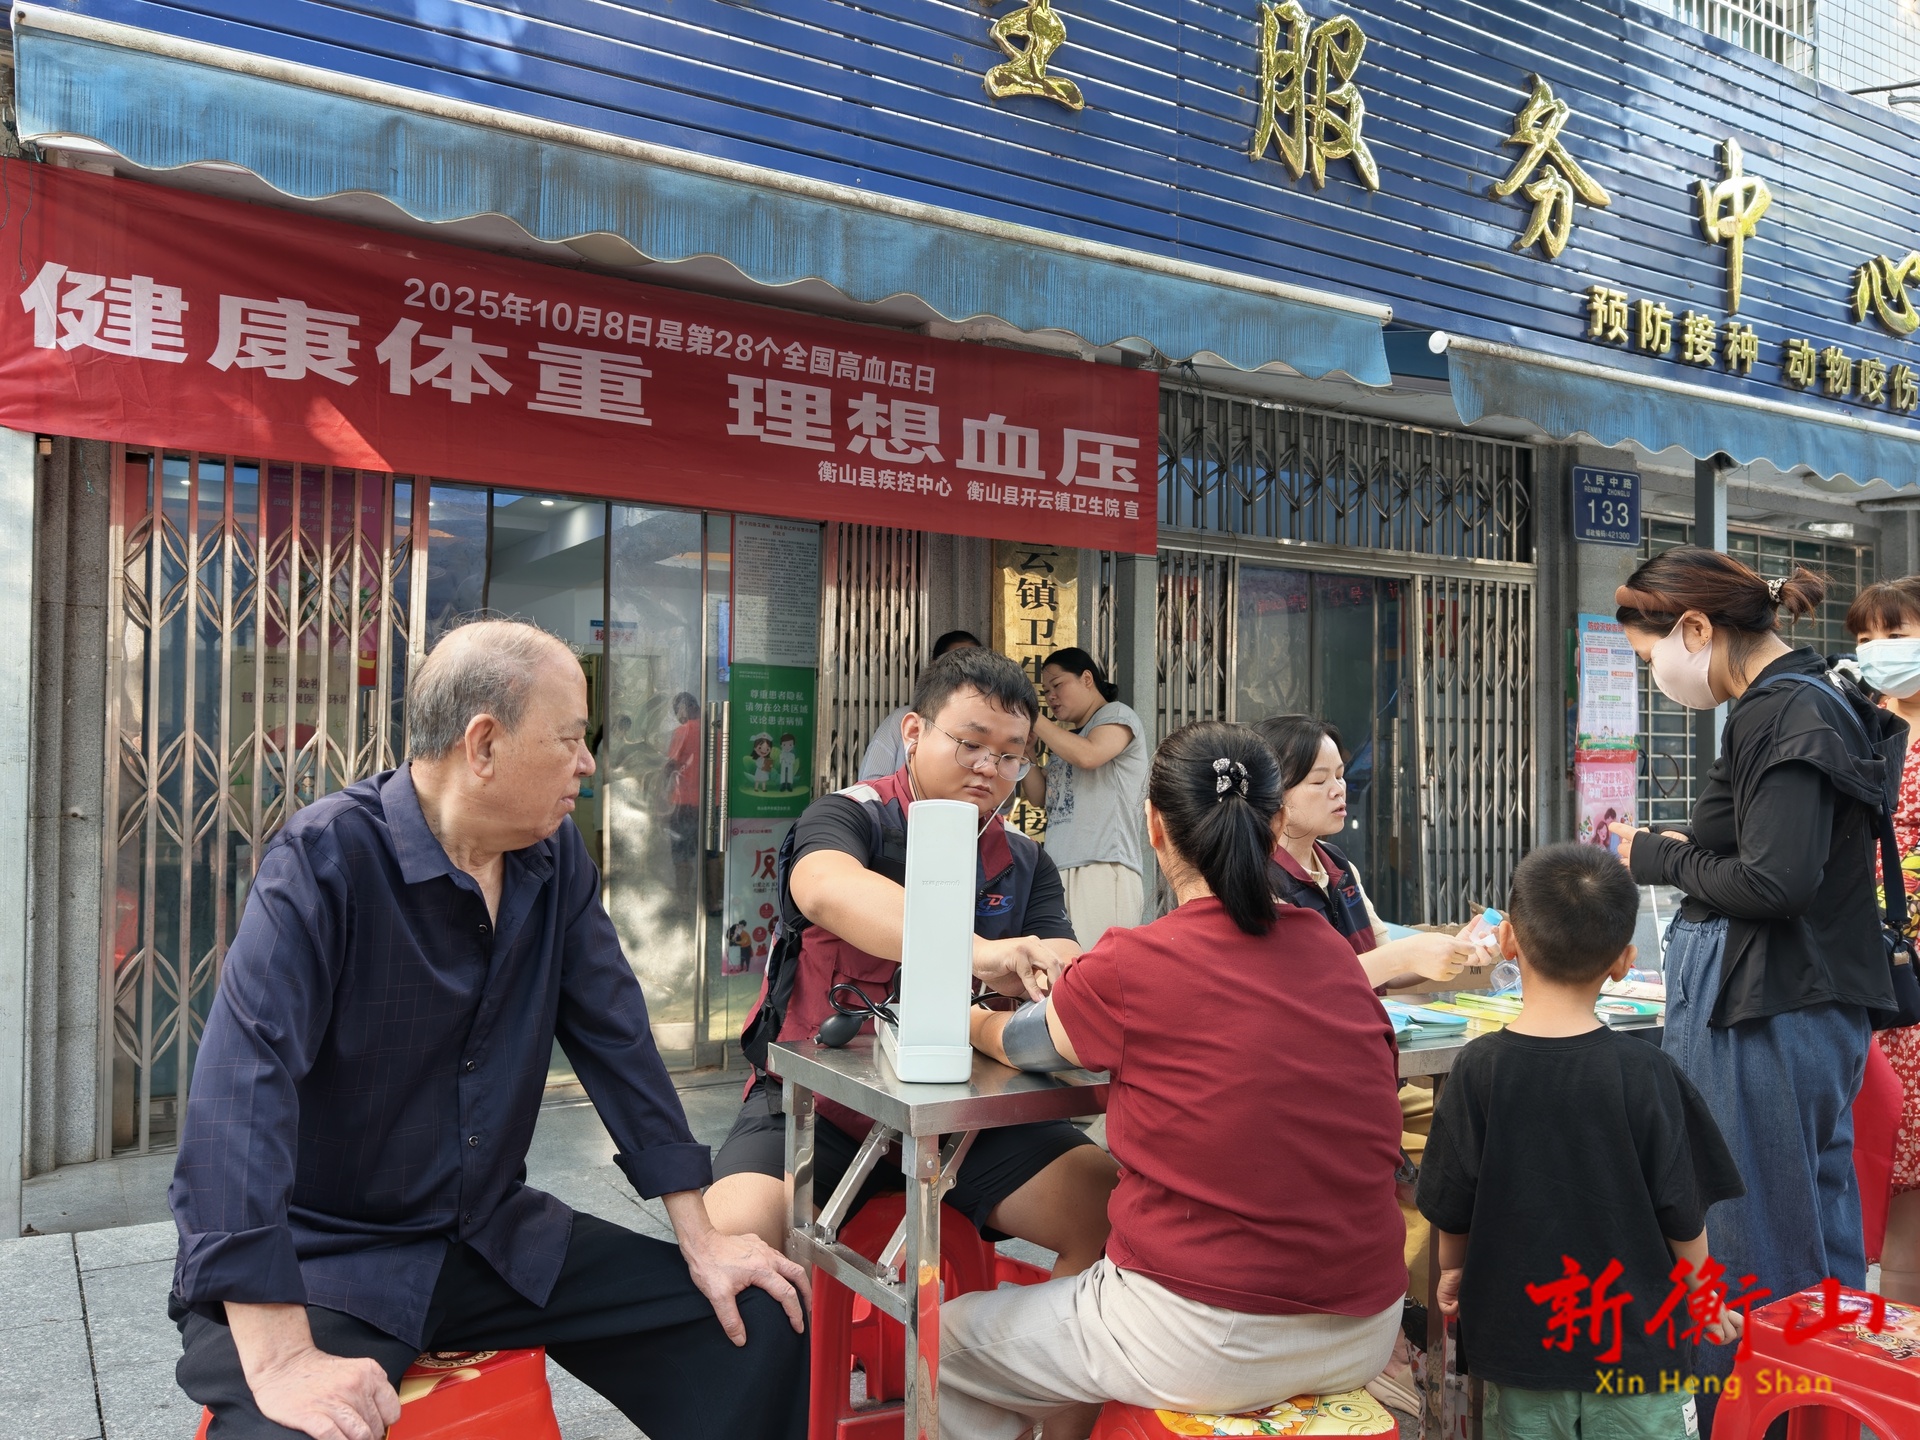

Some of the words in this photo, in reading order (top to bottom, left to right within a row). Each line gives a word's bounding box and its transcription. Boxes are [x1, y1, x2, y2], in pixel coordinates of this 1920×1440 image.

[403, 278, 936, 394] 2025年10月8日是第28个全国高血压日
[1585, 285, 1759, 375] 预防接种
[1783, 339, 1919, 412] 动物咬伤
[20, 261, 653, 427] 健康体重
[727, 374, 1140, 492] 理想血压
[818, 461, 953, 497] 衡山县疾控中心
[967, 481, 1120, 518] 衡山县开云镇卫生院
[1124, 501, 1140, 520] 宣
[1583, 473, 1632, 489] 人民中路
[1584, 485, 1602, 494] RENMIN
[1607, 488, 1631, 498] ZHONGLU
[1588, 499, 1629, 527] 133
[750, 689, 804, 701] 尊重患者隐私
[745, 701, 808, 714] 请勿在公共区域
[749, 714, 804, 726] 议论患者病情
